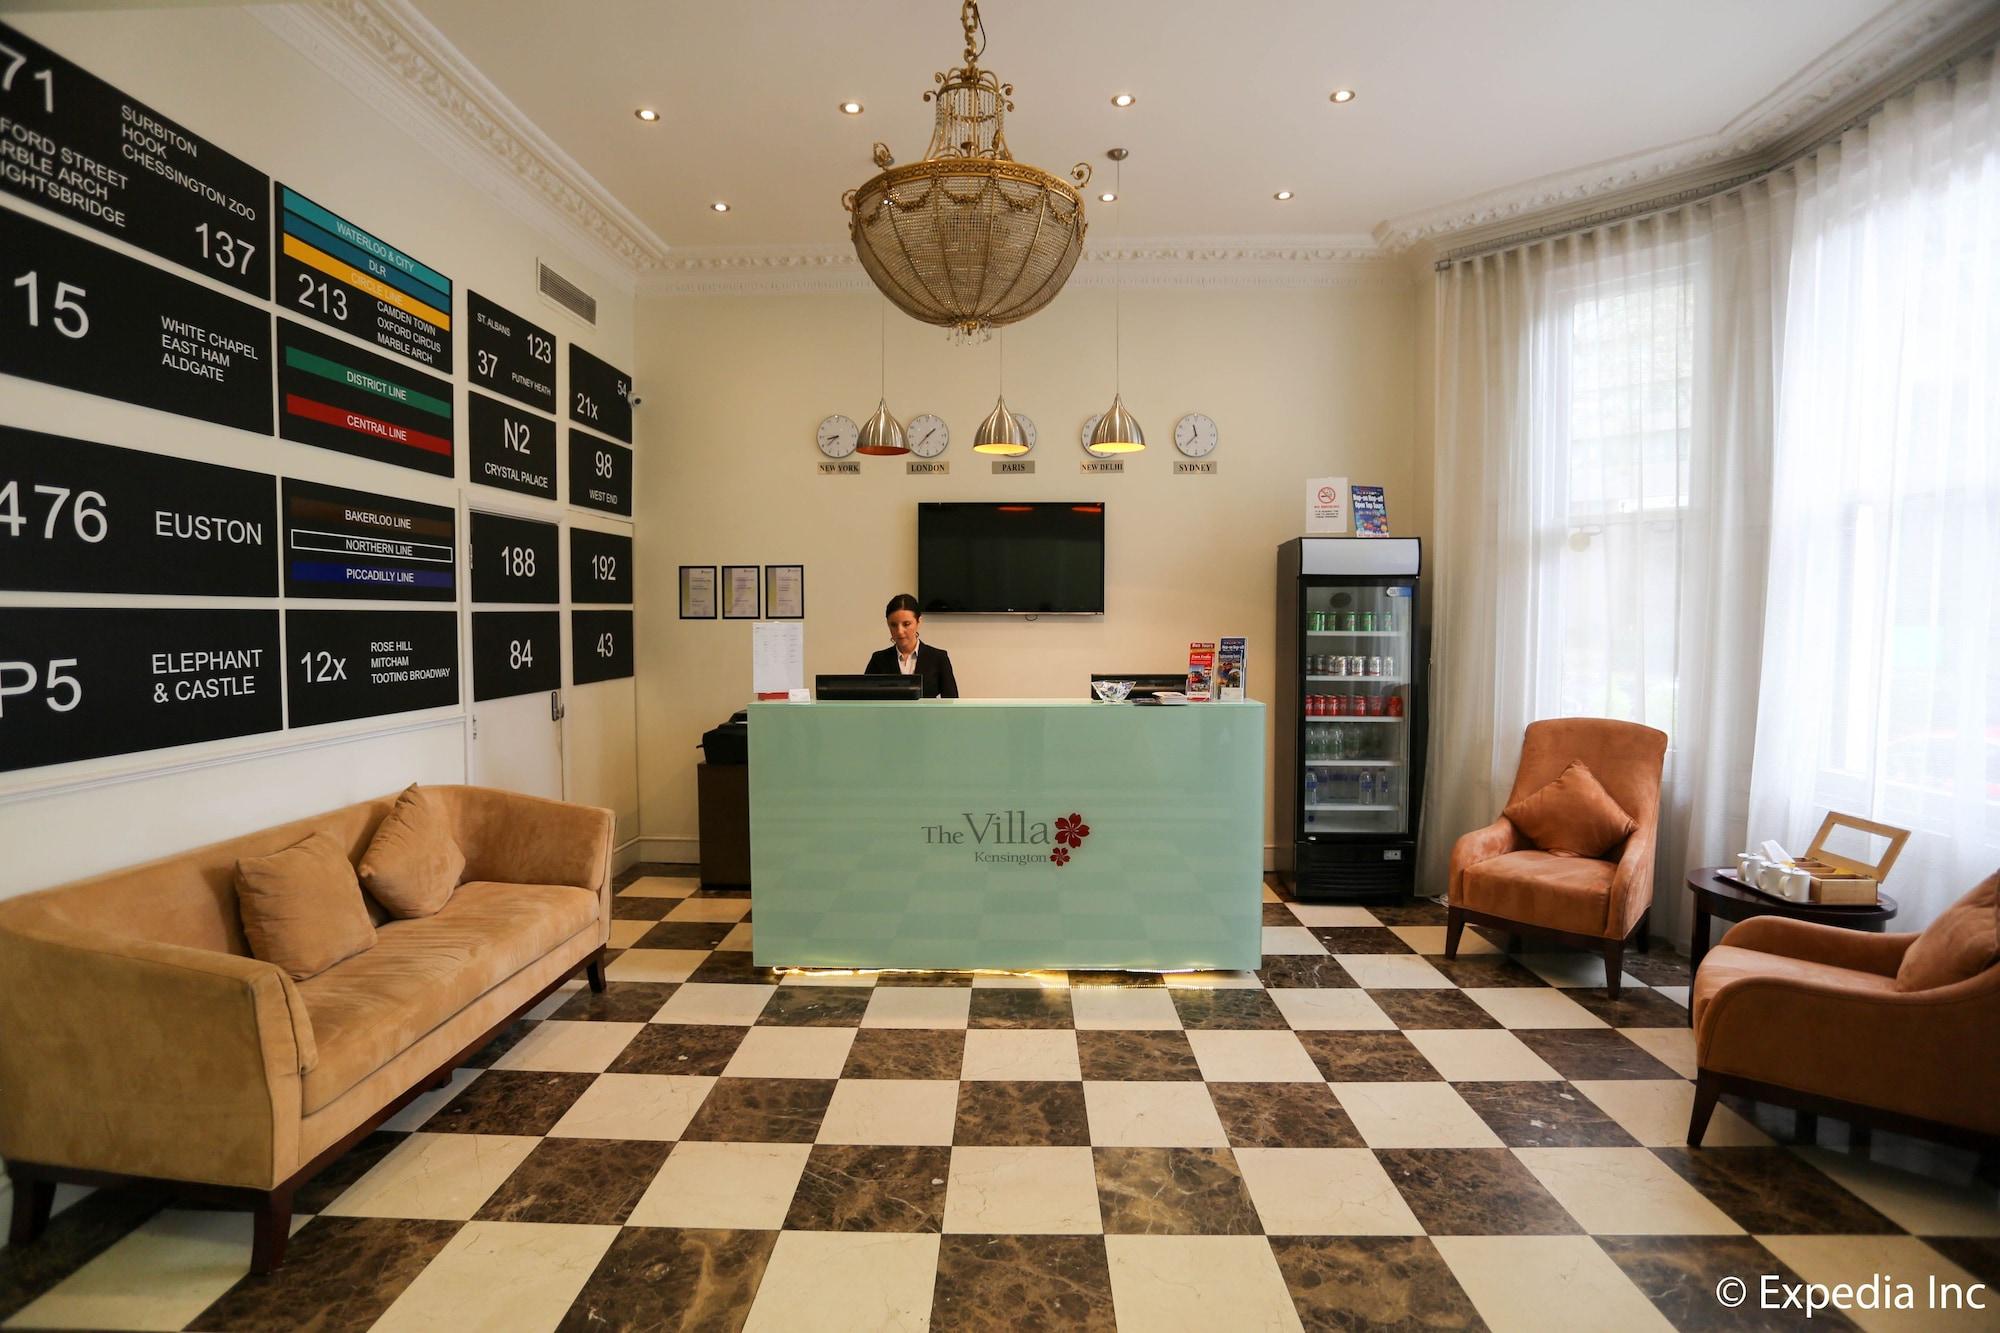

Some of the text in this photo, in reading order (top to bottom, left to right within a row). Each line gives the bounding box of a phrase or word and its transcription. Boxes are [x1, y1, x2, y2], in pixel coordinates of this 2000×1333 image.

[0, 43, 54, 113] 71
[121, 104, 198, 158] SURBITON
[121, 124, 167, 159] HOOK
[0, 140, 108, 201] RBLE ARCH
[60, 147, 128, 190] STREET
[122, 145, 256, 222] CHESSINGTON ZOO
[195, 222, 256, 276] 137
[336, 220, 415, 273] WATERLOO & CITY
[368, 259, 387, 278] DLR
[14, 271, 90, 340] 15
[298, 273, 348, 321] 213
[376, 300, 436, 337] CAMDEN TOWN
[477, 312, 512, 337] ST. ALBANS
[161, 315, 259, 361] WHITE CHAPEL
[376, 316, 441, 353] OXFORD CIRCUS
[376, 331, 433, 364] MARBLE ARCH
[527, 333, 551, 364] 123
[162, 334, 230, 368] EAST HAM
[477, 349, 498, 379] 37
[162, 352, 225, 383] ALDGATE
[346, 370, 407, 401] DISTRICT LINE
[511, 371, 551, 397] PUTNEY HEATH
[617, 380, 627, 397] 54
[576, 393, 599, 420] 21x
[346, 415, 407, 442] CENTRAL LINE
[504, 418, 531, 455] N2
[484, 462, 549, 489] CRYSTAL PALACE
[595, 450, 613, 479] 98
[819, 464, 860, 473] NEW YORK
[911, 464, 946, 473] LONDON
[1002, 463, 1026, 472] PARIS
[1081, 463, 1124, 471] NEW DELHI
[1178, 463, 1212, 472] SYDNEY
[0, 480, 109, 544] 476
[589, 489, 618, 505] WEST END
[155, 510, 263, 546] EUSTON
[344, 509, 412, 529] BAKERLOO LINE
[345, 538, 413, 557] NORTHERN LINE
[501, 546, 536, 578] 188
[346, 568, 415, 583] PICCADILLY LINE
[592, 554, 617, 581] 192
[371, 641, 413, 652] ROSE HILL
[509, 639, 534, 670] 84
[596, 632, 614, 658] 43
[152, 649, 263, 674] ELEPHANT
[300, 650, 348, 684] 12x
[370, 656, 409, 668] MITCHAM
[371, 667, 451, 684] TOOTING BROADWAY
[0, 657, 83, 719] P5
[153, 675, 256, 703] & CASTLE
[921, 810, 1051, 845] The Villa
[974, 851, 1047, 866] Kensington
